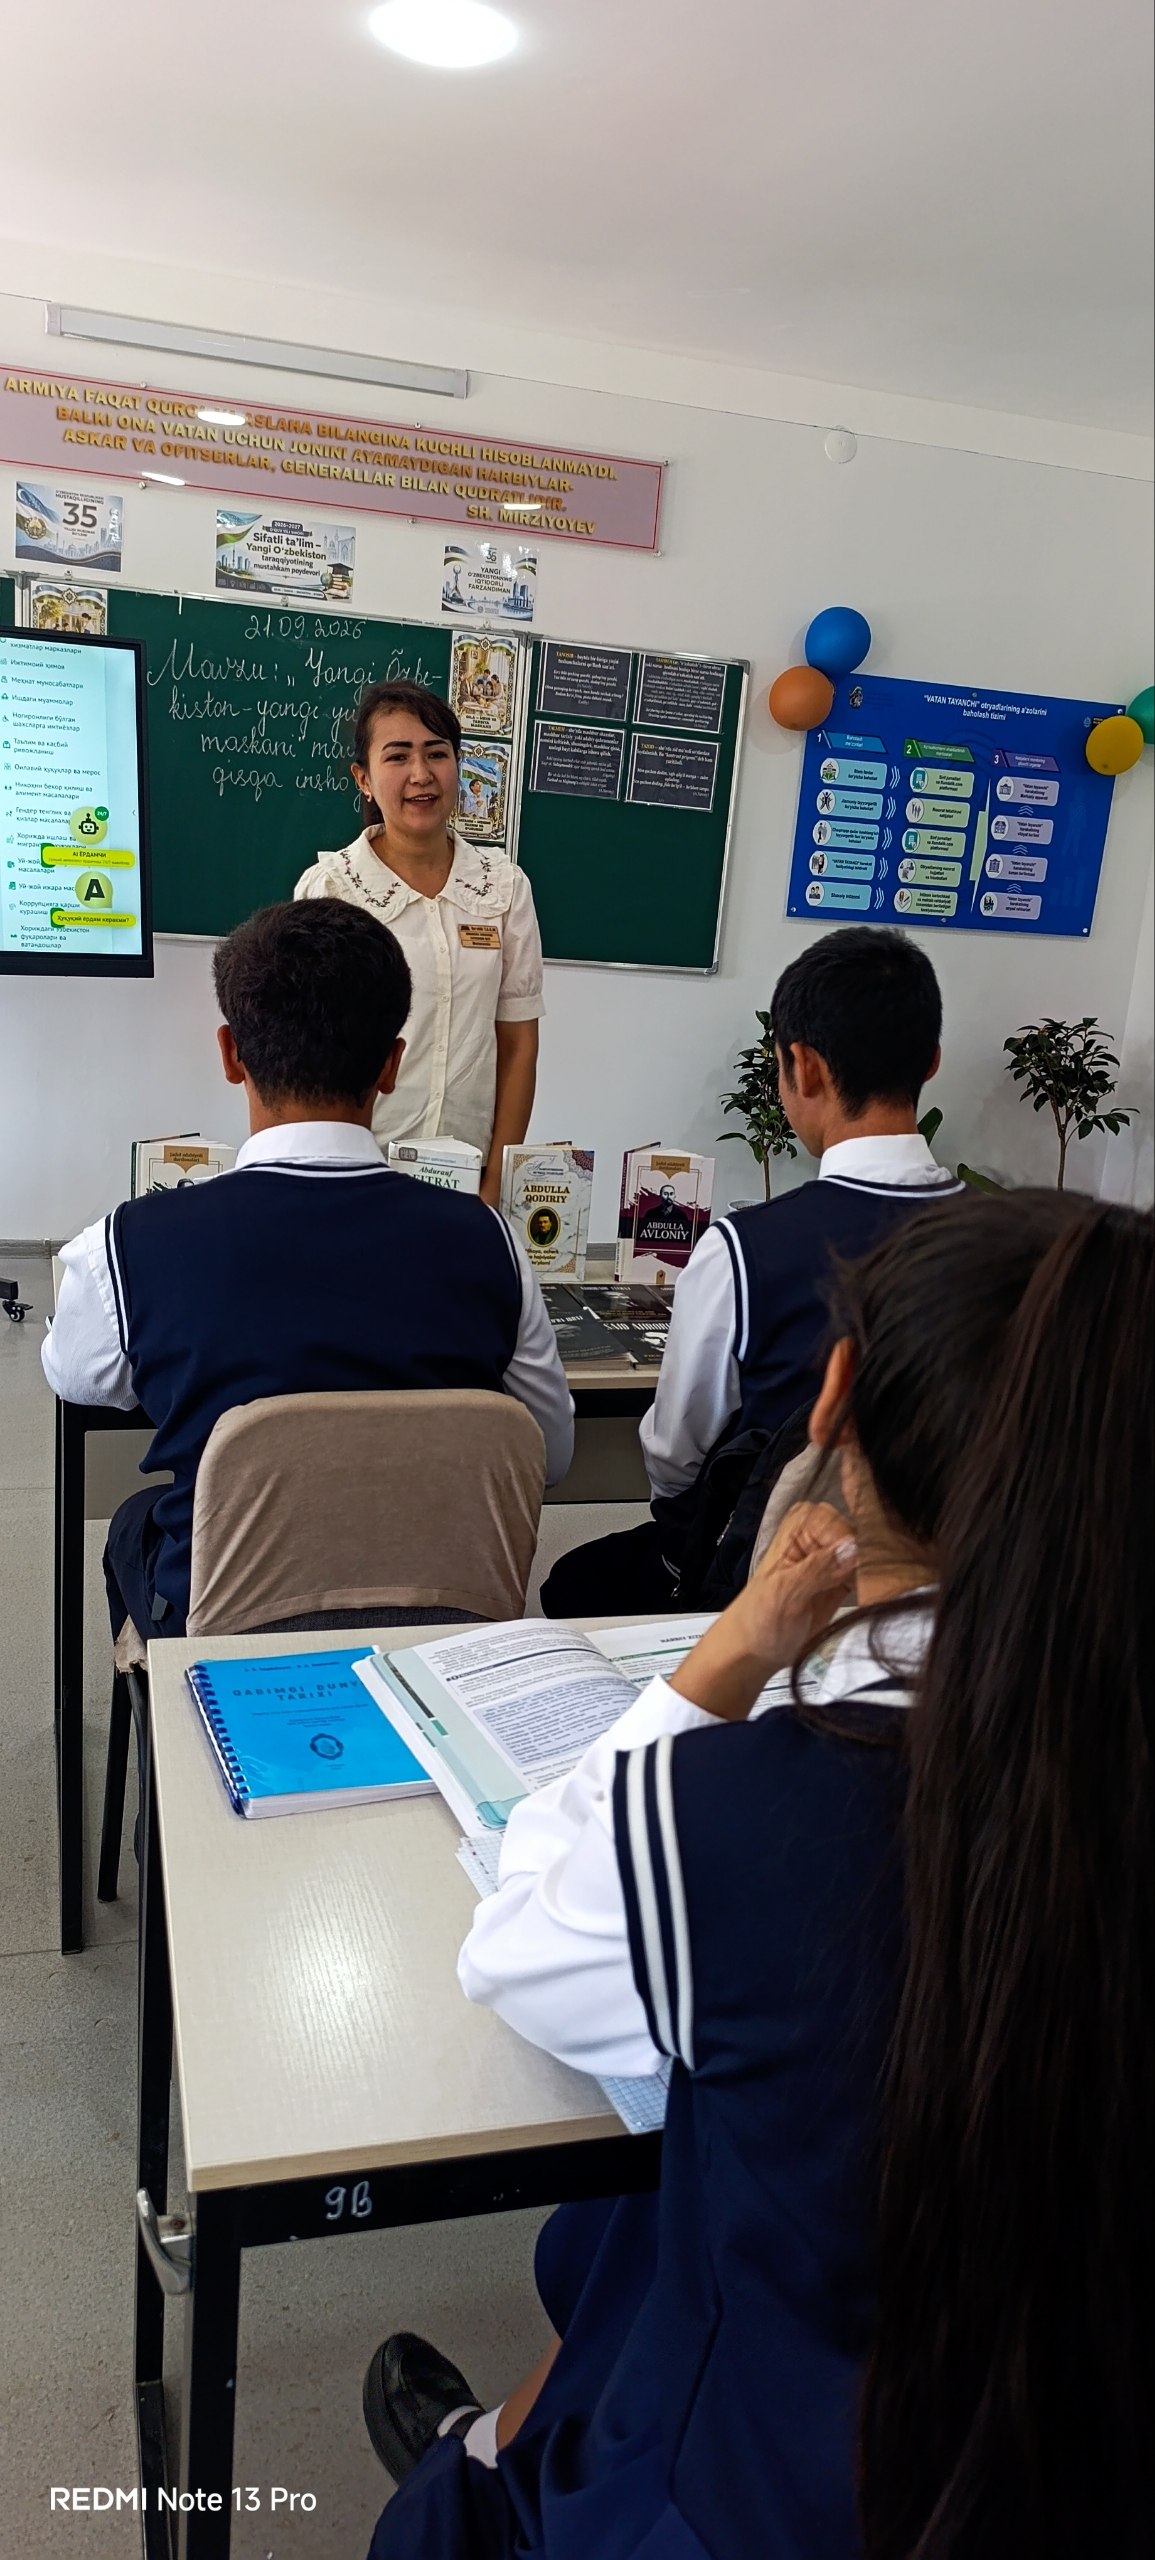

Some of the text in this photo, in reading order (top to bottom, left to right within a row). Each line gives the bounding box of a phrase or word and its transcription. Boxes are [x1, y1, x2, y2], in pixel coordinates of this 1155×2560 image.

[5, 377, 79, 400] ARMIYA
[85, 388, 141, 410] FAQAT
[147, 397, 206, 419] QURO
[317, 424, 411, 449] BILANGINA
[415, 438, 477, 459] KUCHLI
[481, 447, 618, 481] HISOBLANMAYDI.
[56, 406, 112, 426] BALKI
[117, 415, 157, 433] ONA
[162, 421, 219, 442] VATAN
[224, 429, 286, 451] UCHUN
[290, 440, 349, 460] JONINI
[353, 449, 474, 478] AYAMAYDIGAN
[64, 428, 127, 451] ASKAR
[133, 437, 157, 454] VA
[161, 442, 276, 473] OFITSERLAR,
[281, 458, 397, 487] GENERALLAR
[401, 475, 450, 495] BILAN
[62, 502, 97, 528] 35
[467, 504, 596, 534] SH. MIRZIYOYEV
[253, 532, 283, 545] Sifatli
[246, 543, 271, 554] Yangi
[261, 555, 314, 568] taraqqiyotining
[253, 563, 321, 577] mustahkam poydevori
[481, 566, 501, 575] YANGI
[474, 578, 504, 587] IQTIDORLI
[468, 584, 511, 594] FARZANDIMAN
[245, 614, 367, 640] 21.09.2026
[45, 645, 82, 654] марказлари
[10, 659, 44, 667] Ижтимоий
[37, 680, 84, 689] муносабатлари
[38, 697, 73, 706] муаммолар
[980, 702, 1021, 714] otryadlarining
[12, 712, 54, 721] Ногиронлиги
[963, 709, 989, 719] baholash
[13, 721, 46, 729] шахсларга
[817, 733, 822, 743] 1
[13, 747, 54, 755] ривожланиш
[906, 744, 912, 754] 2
[994, 754, 999, 764] 3
[14, 763, 42, 771] Оилавий
[295, 765, 350, 792] insho
[43, 792, 79, 800] масалалари
[19, 900, 58, 908] Коррупцияга
[419, 1166, 454, 1177] Abdurauf
[523, 1185, 570, 1194] ABDULLA
[525, 1194, 568, 1204] QODIRIY
[646, 1221, 684, 1231] ABDULLA
[640, 1229, 689, 1240] AVLONIY
[232, 1680, 358, 1697] QADIMGI DUNY
[277, 1691, 333, 1701] TARIXI
